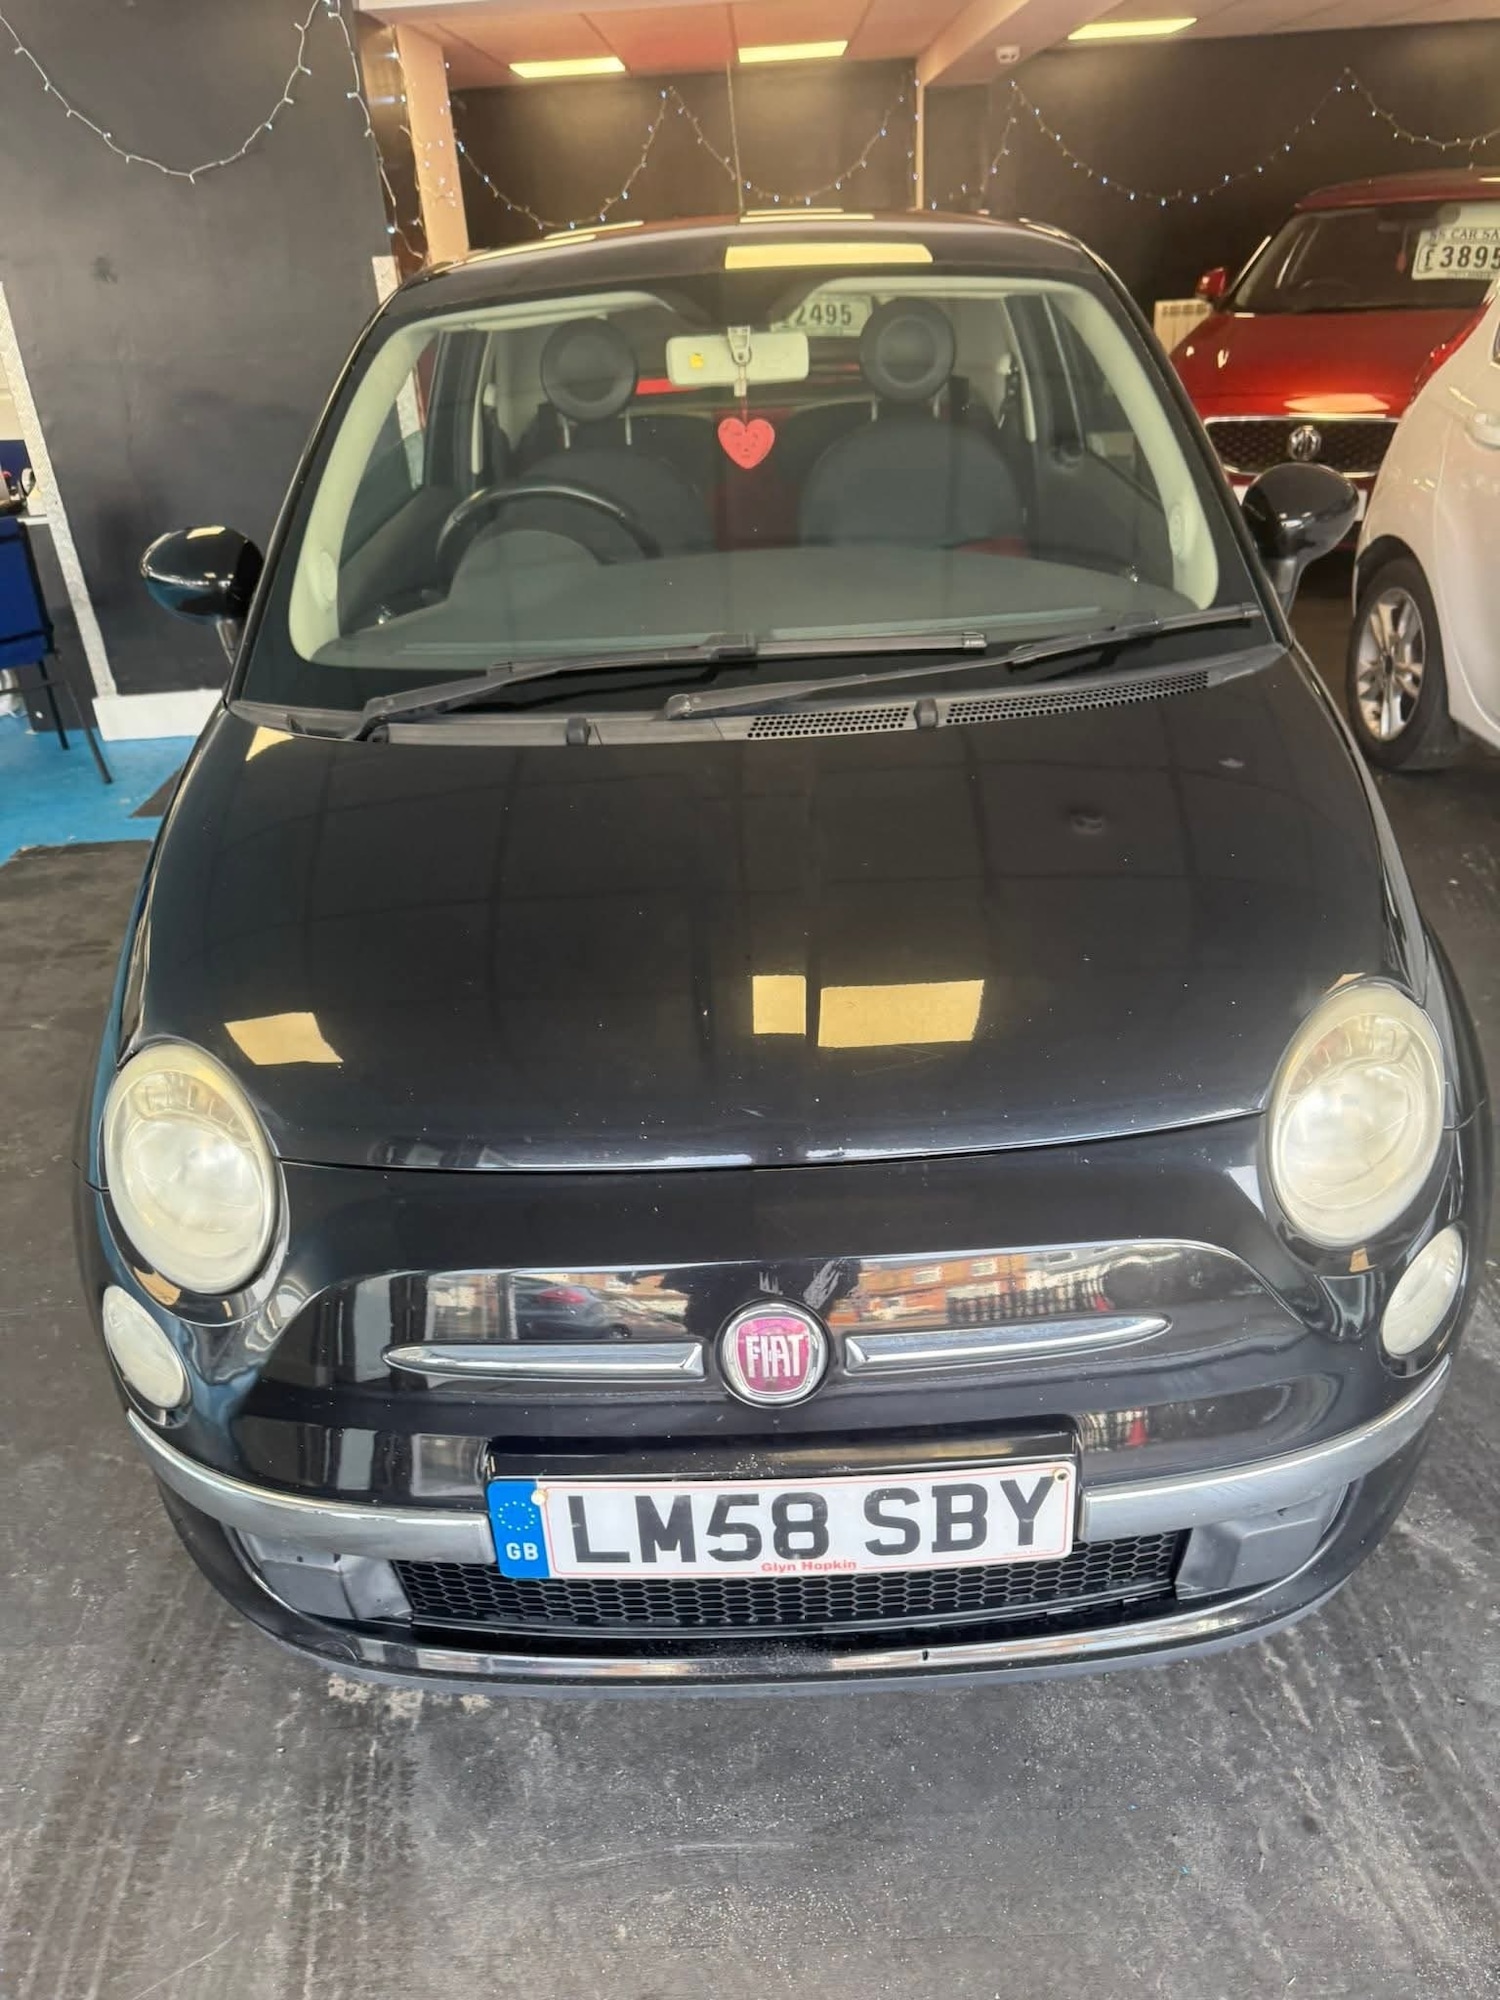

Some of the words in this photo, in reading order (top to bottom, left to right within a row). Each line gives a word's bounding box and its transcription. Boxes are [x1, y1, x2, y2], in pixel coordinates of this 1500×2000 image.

[745, 1334, 807, 1378] FIAT
[567, 1492, 830, 1563] LM58
[863, 1476, 1056, 1556] SBY
[506, 1542, 539, 1561] GB
[761, 1562, 797, 1573] Glyn
[801, 1560, 857, 1571] Hopkin
